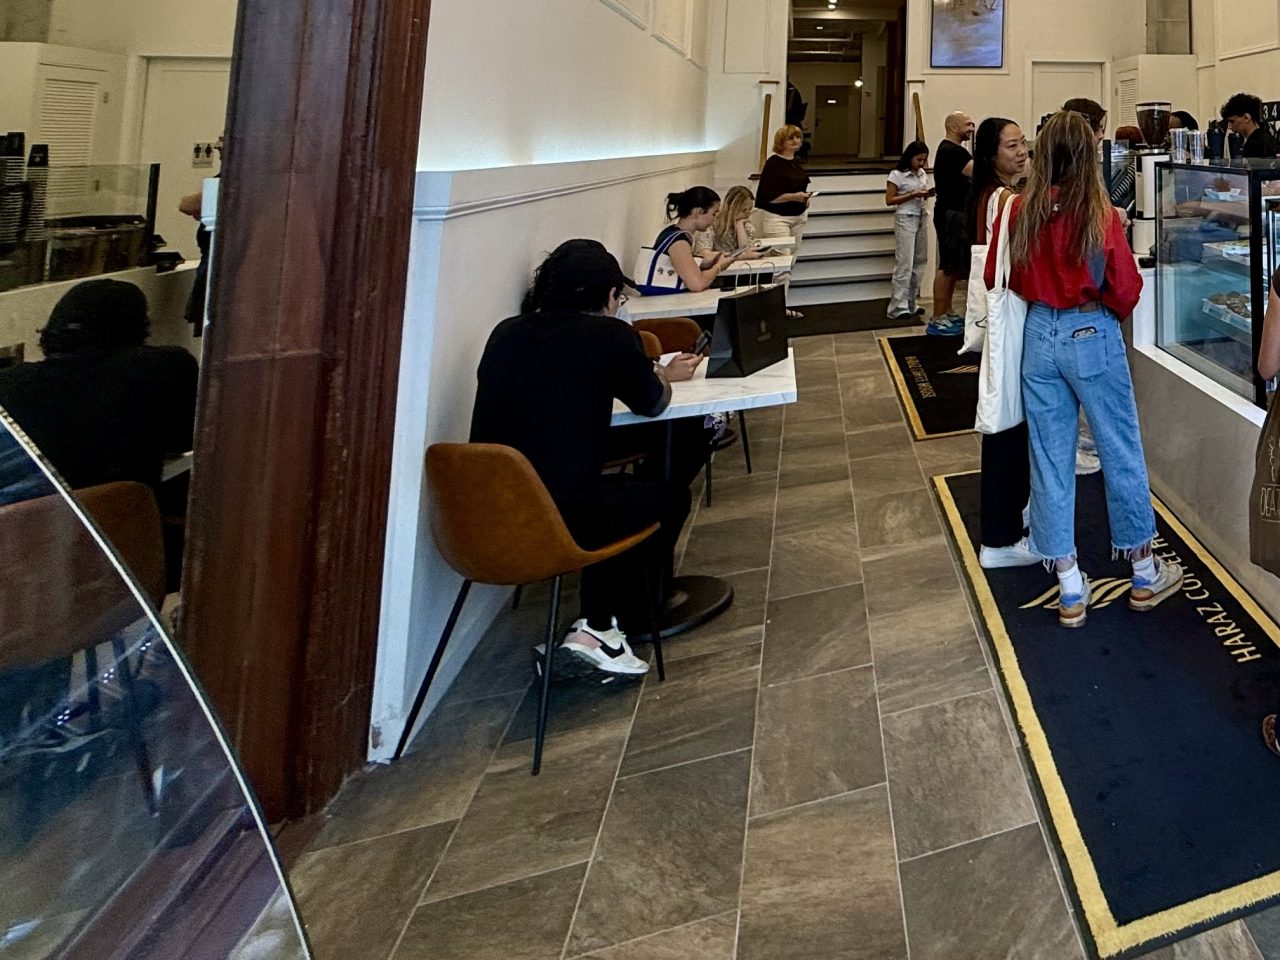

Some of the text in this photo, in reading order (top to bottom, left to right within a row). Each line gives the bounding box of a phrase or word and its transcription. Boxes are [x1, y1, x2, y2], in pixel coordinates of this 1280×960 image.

[1263, 105, 1269, 119] 3
[1271, 104, 1278, 118] 4
[1196, 601, 1262, 663] HARAZ
